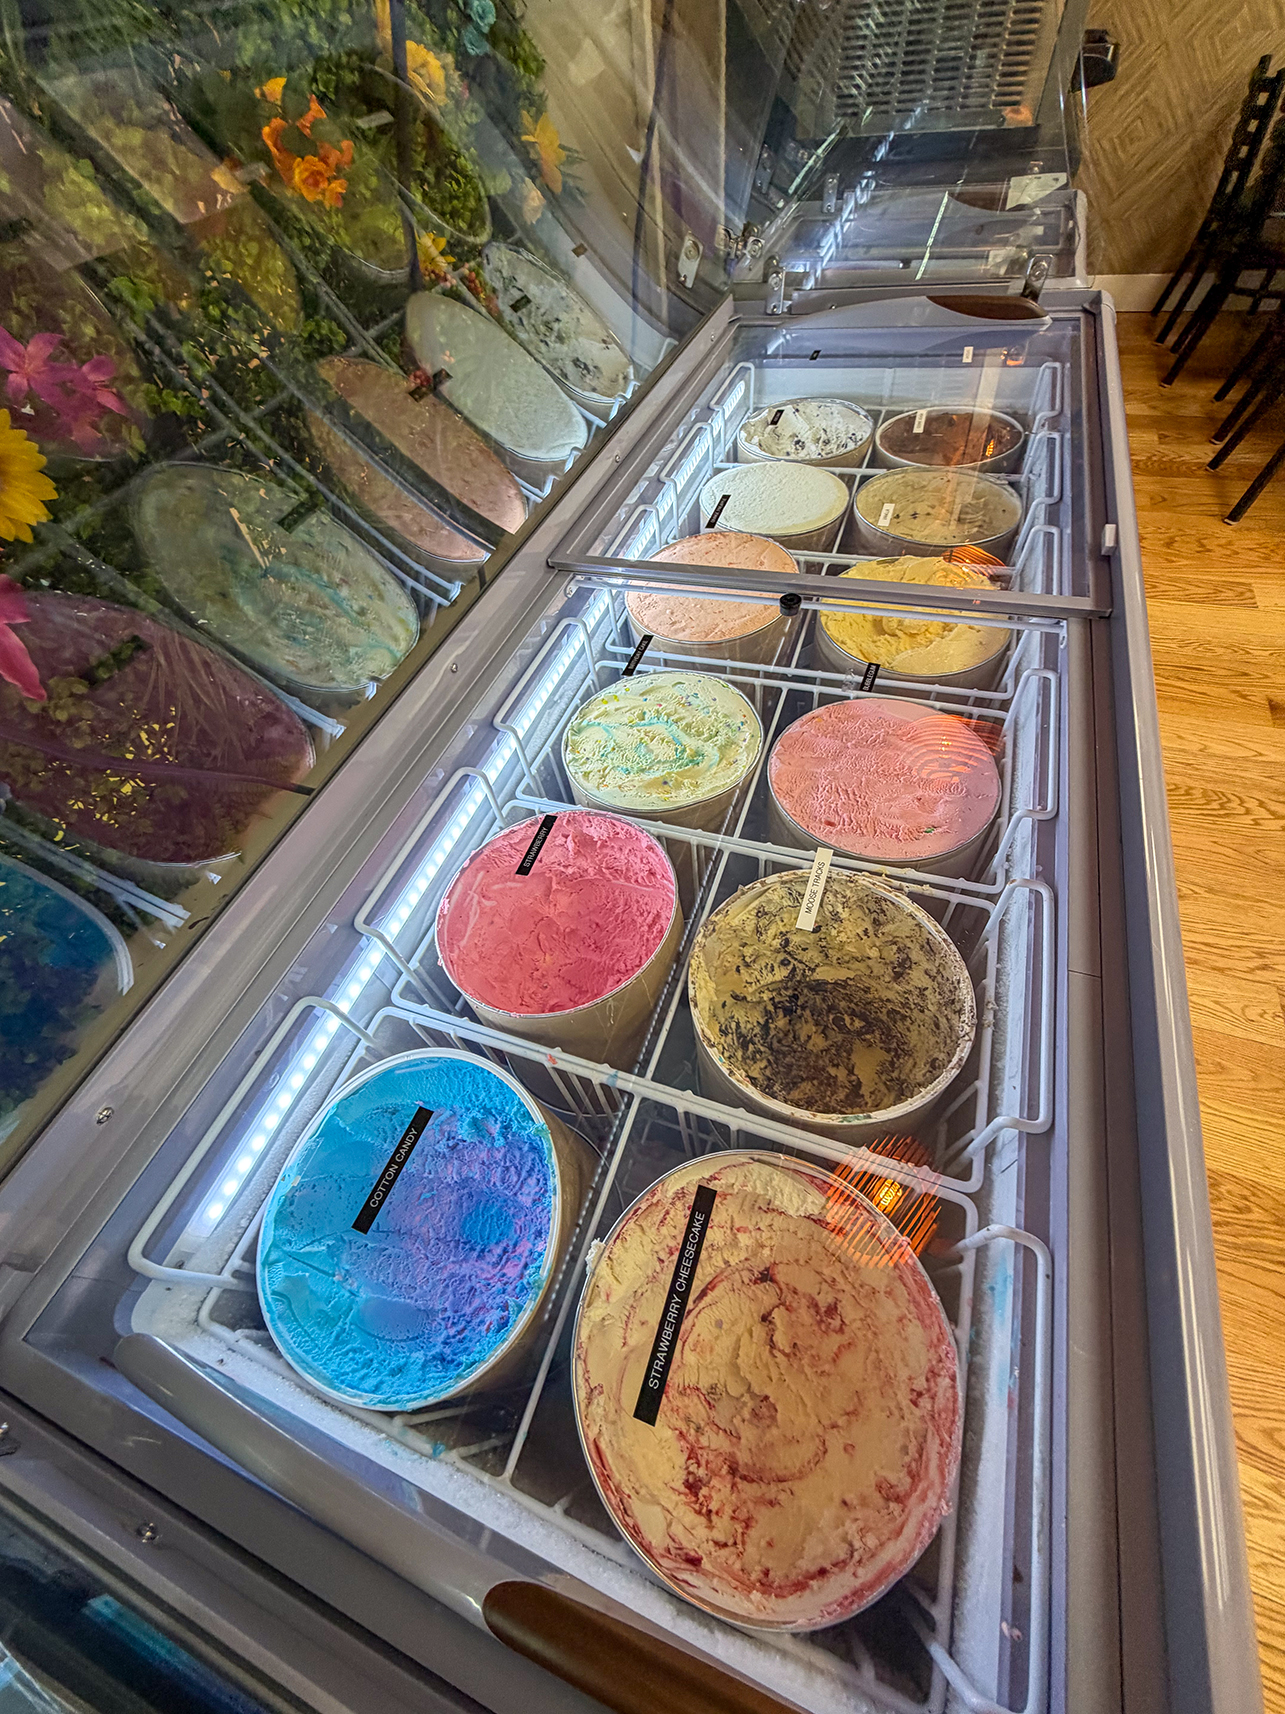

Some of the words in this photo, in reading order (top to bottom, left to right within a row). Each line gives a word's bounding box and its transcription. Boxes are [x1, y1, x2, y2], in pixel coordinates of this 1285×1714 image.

[523, 826, 549, 868] STRAWBERRY
[804, 889, 818, 915] MOOSE
[812, 861, 826, 888] TRACKS
[369, 1163, 399, 1208] COTTON
[395, 1127, 418, 1162] CANDY
[648, 1293, 682, 1390] STRAWBERRY
[675, 1211, 705, 1292] CHEESECAKE
